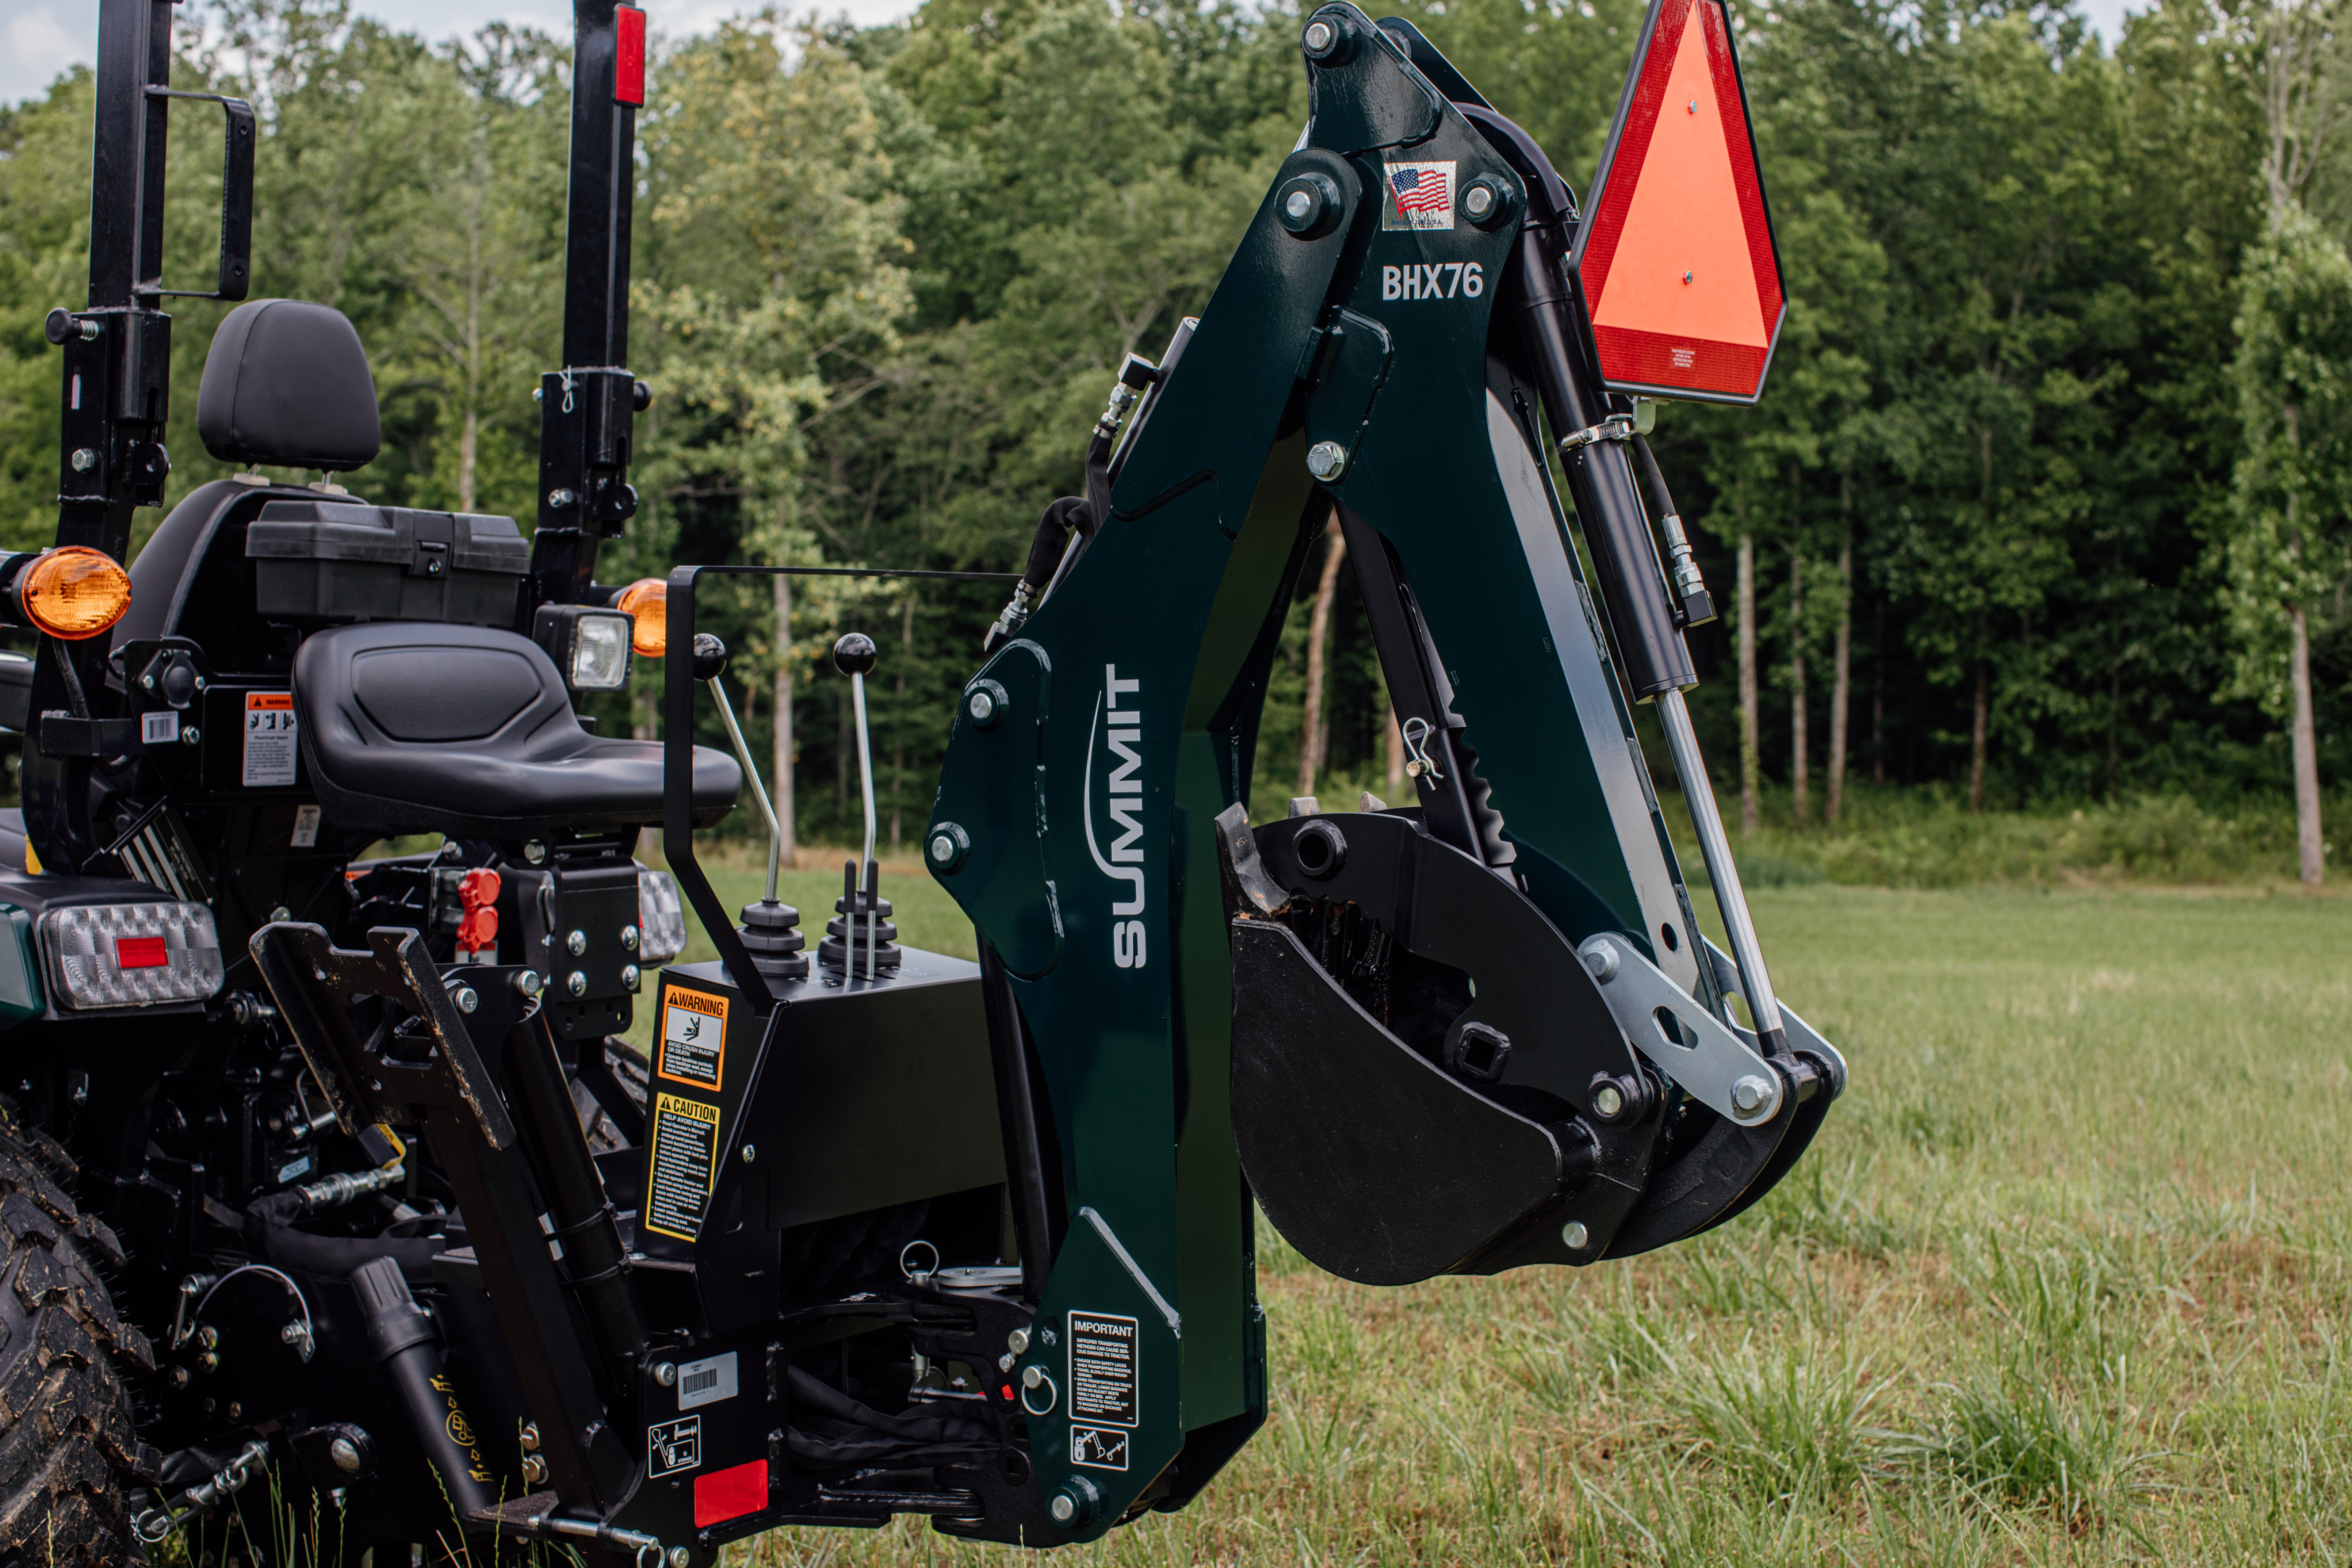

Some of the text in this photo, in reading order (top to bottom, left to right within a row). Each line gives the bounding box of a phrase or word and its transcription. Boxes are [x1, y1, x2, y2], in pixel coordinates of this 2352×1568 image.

[1383, 262, 1483, 301] BHX76
[1085, 664, 1147, 968] SUMMIT
[679, 994, 723, 1015] WARNING
[682, 1044, 697, 1052] CRUSH
[676, 1060, 691, 1068] backhoe
[665, 1067, 682, 1075] backhoe.
[676, 1065, 693, 1074] installing
[698, 1071, 715, 1080] removing
[674, 1099, 716, 1121] CAUTION
[672, 1123, 691, 1131] Operator's
[677, 1117, 692, 1125] AVOID
[693, 1121, 711, 1129] INJURY
[661, 1133, 704, 1147] underground powerlines.
[672, 1153, 689, 1161] operating.
[669, 1158, 688, 1166] bystanders
[665, 1169, 684, 1177] stabilizers.
[675, 1194, 688, 1202] locking
[655, 1201, 677, 1211] transporting.
[666, 1215, 679, 1223] leaving
[1075, 1321, 1132, 1336] IMPORTANT
